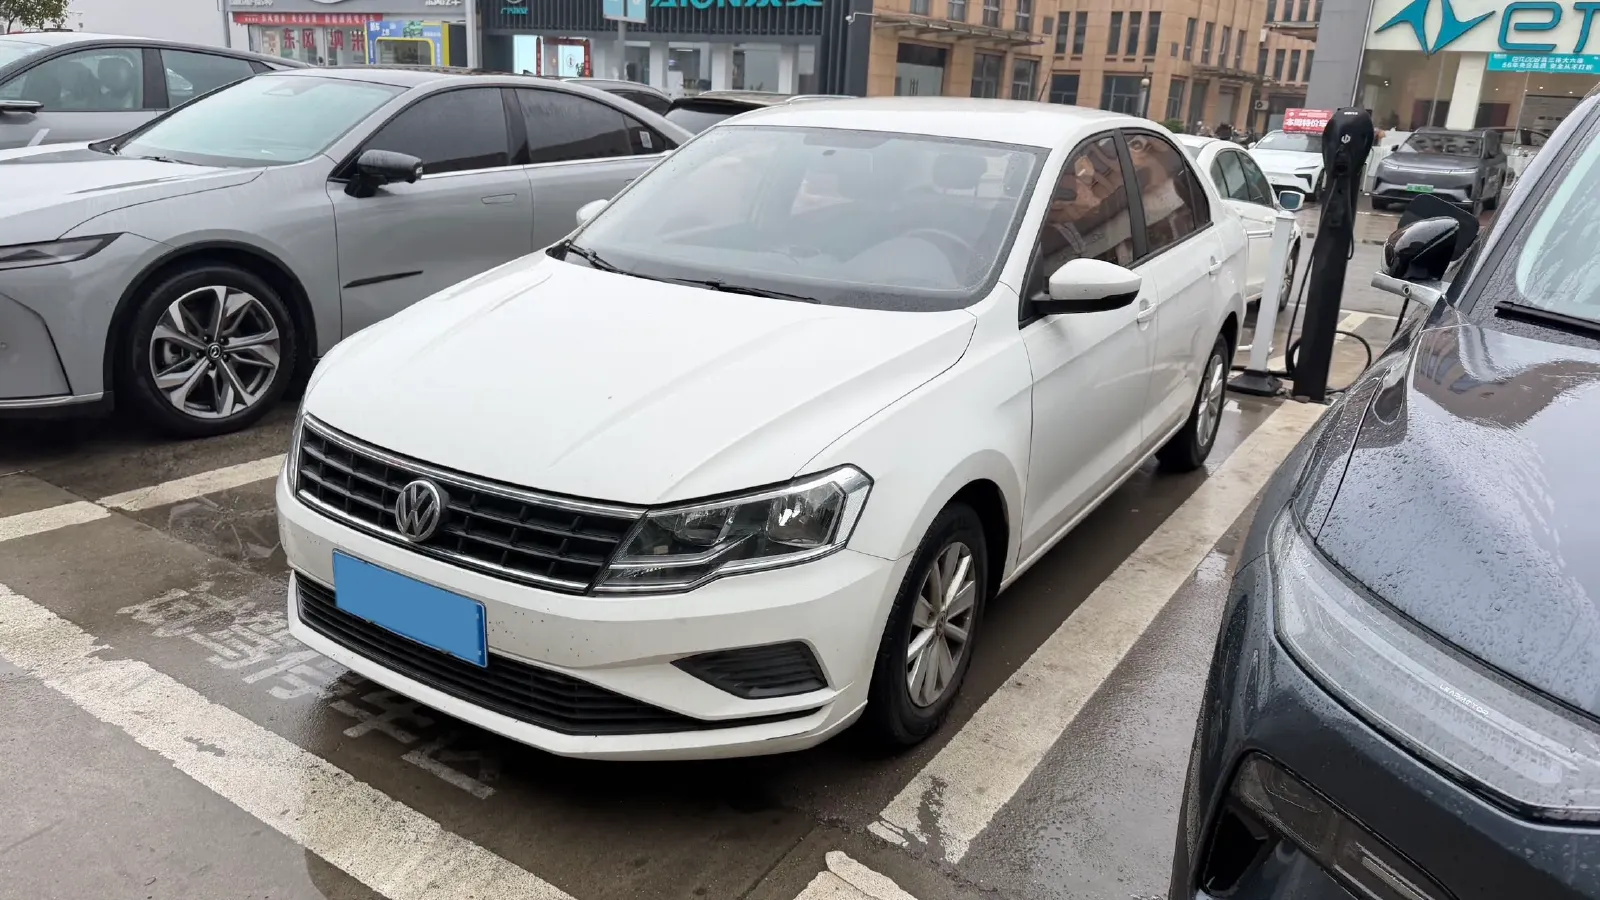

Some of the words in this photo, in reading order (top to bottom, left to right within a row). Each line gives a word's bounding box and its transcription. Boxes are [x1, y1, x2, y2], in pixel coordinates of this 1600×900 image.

[283, 28, 365, 52] 东风纳米
[1286, 118, 1328, 127] 本周特价车
